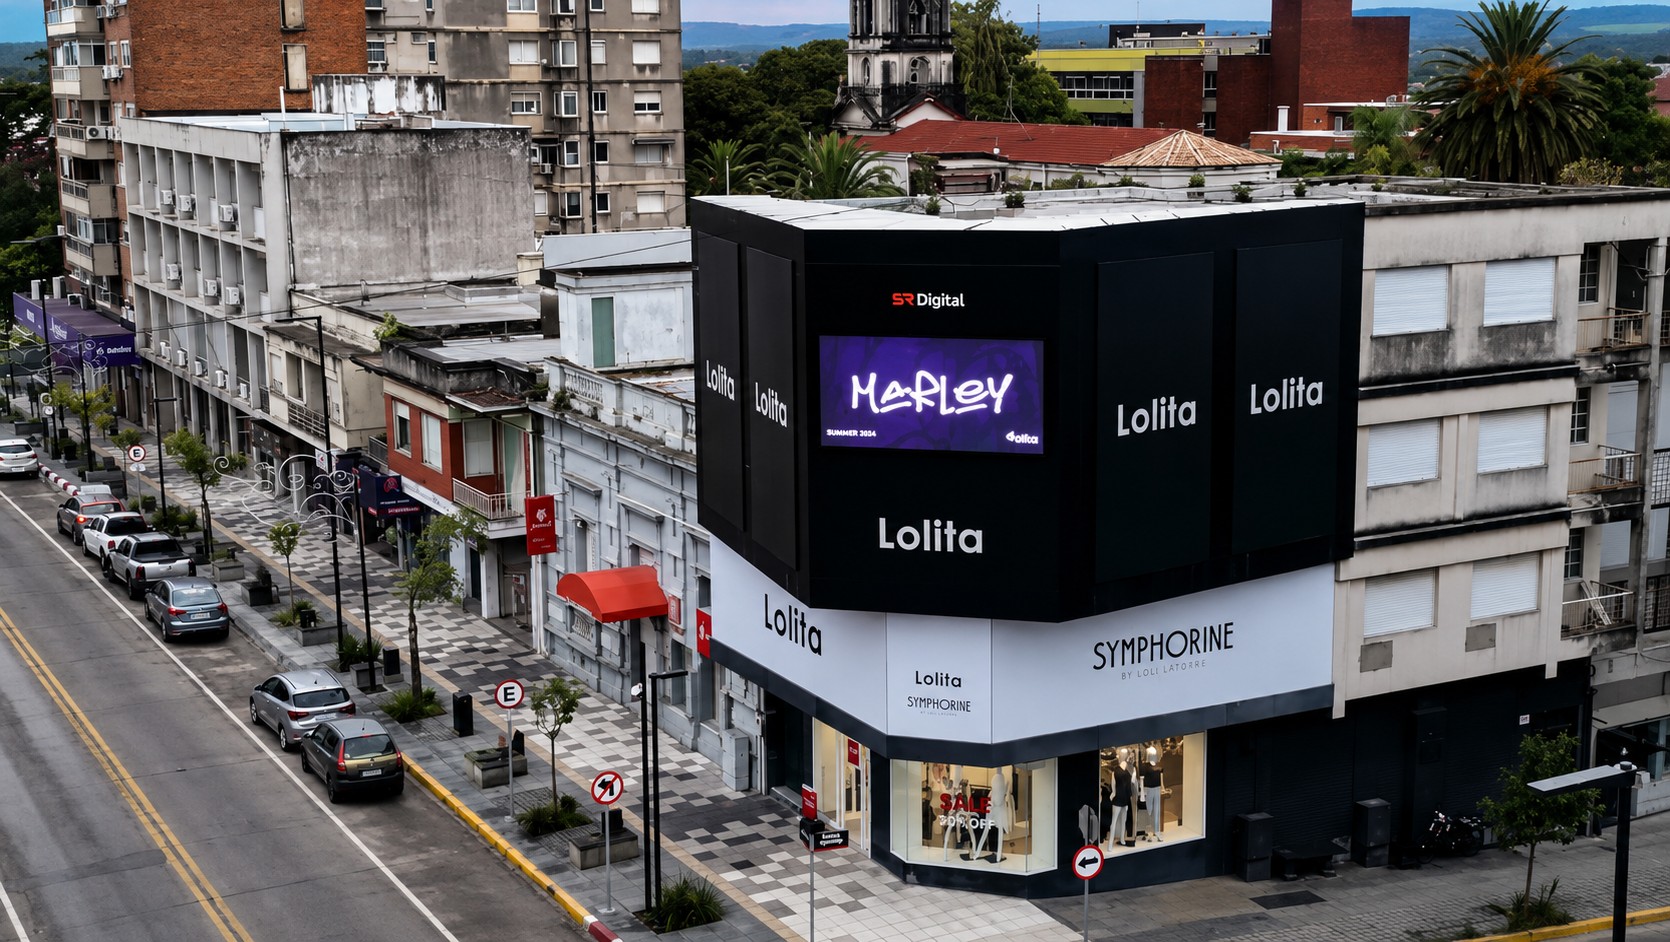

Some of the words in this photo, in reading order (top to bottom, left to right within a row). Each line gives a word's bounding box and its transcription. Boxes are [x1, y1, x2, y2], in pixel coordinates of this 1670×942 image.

[892, 292, 915, 306] SR
[916, 292, 965, 310] Digital
[705, 358, 736, 402] Lolita
[754, 380, 789, 430] Lolita
[1250, 376, 1323, 415] Lolita
[1117, 395, 1197, 438] Lolita
[826, 428, 858, 437] SUMMER
[878, 516, 983, 556] Lolita
[764, 593, 823, 657] Lolita
[1092, 621, 1234, 671] SYMPHORINE
[915, 670, 962, 688] Lolita
[1121, 671, 1132, 681] BY
[1137, 667, 1159, 678] LOLI
[1163, 659, 1207, 674] LATORRE
[503, 685, 516, 703] E
[907, 695, 971, 713] SYMPHORINE
[939, 792, 992, 814] SALE
